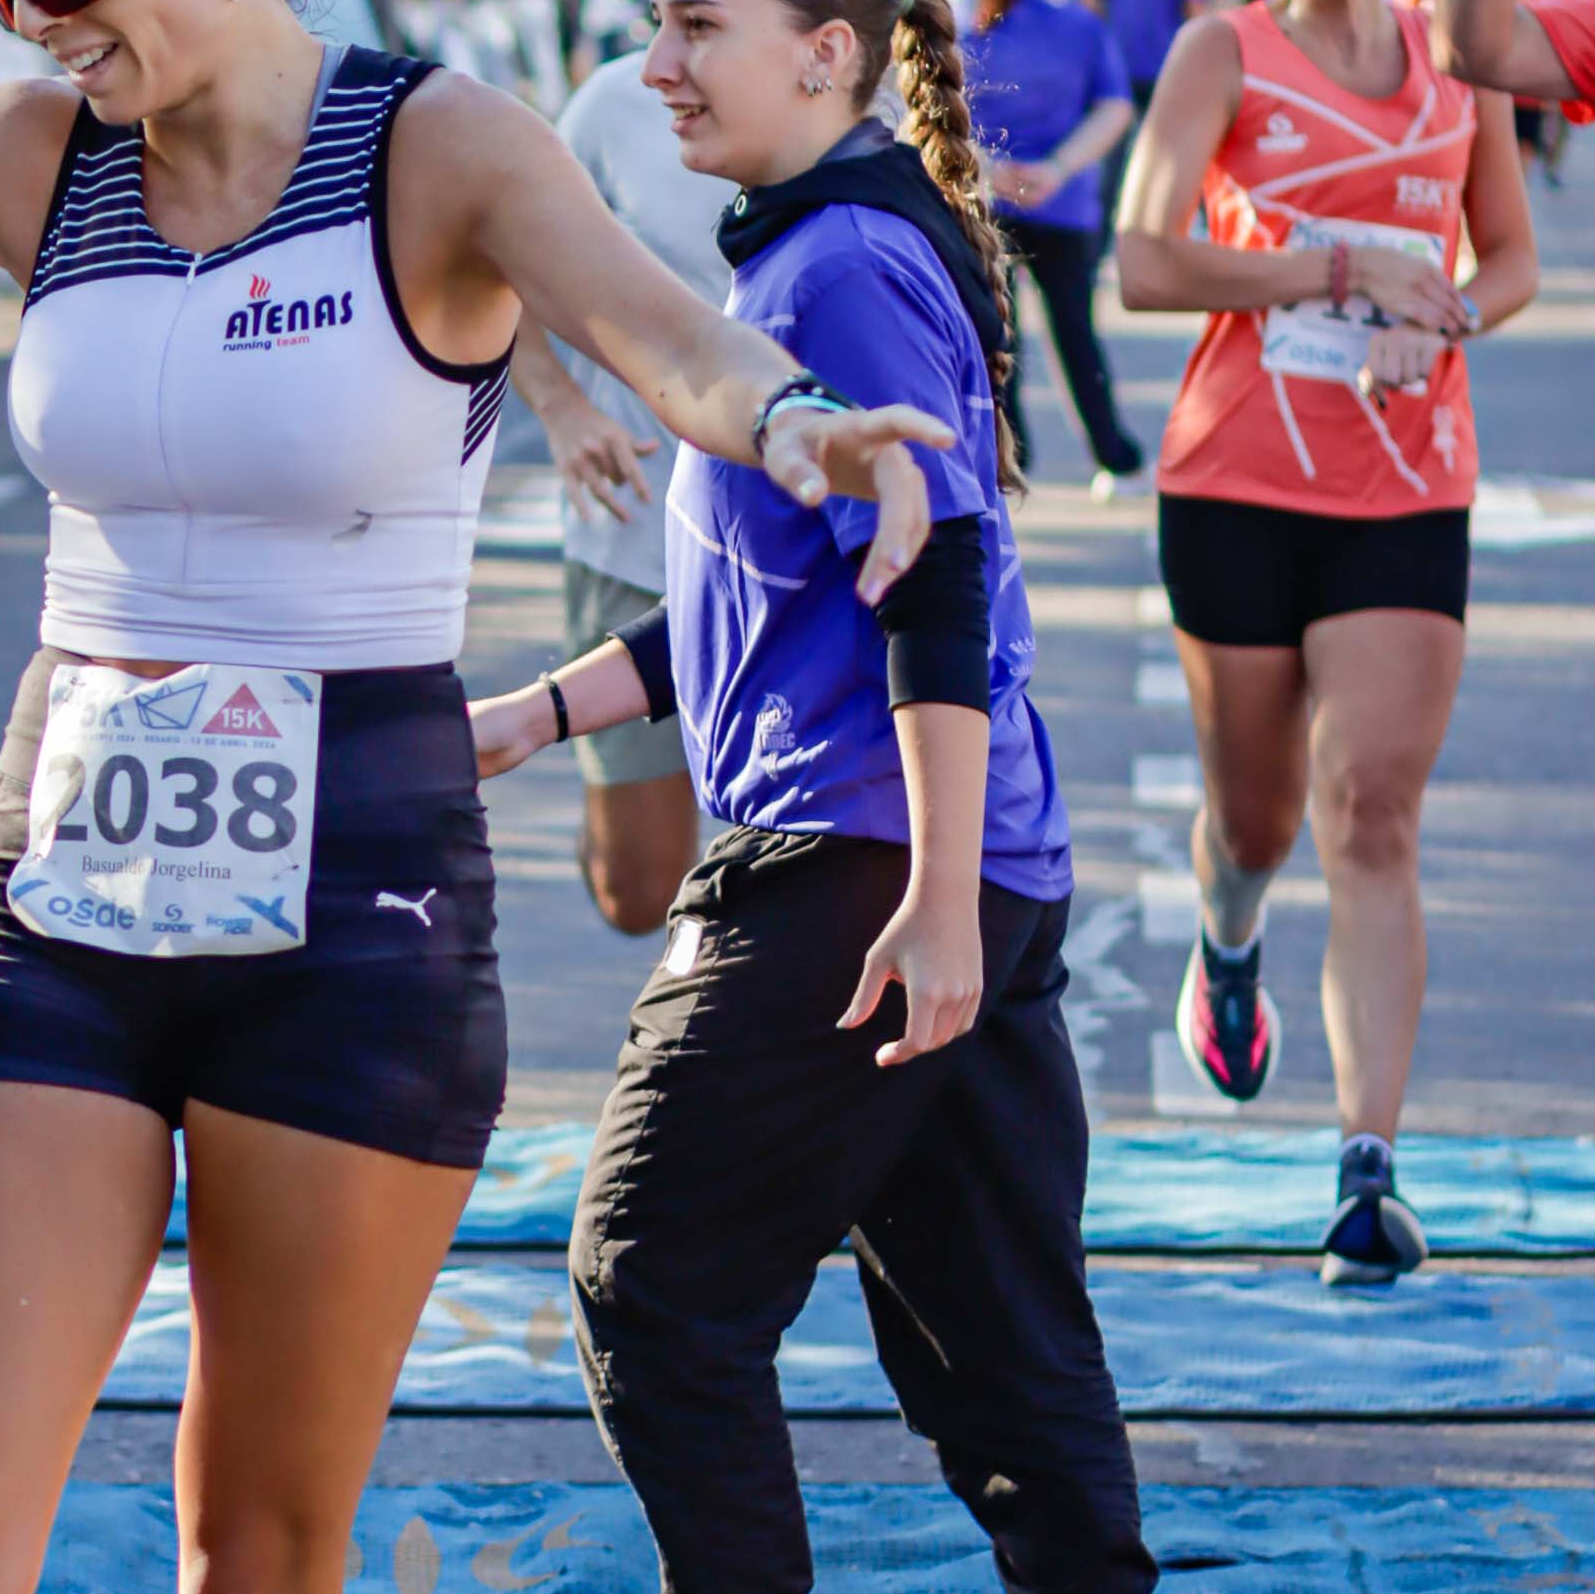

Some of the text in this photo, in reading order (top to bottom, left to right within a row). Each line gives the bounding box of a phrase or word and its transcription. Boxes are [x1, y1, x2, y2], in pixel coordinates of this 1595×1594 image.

[225, 291, 353, 340] ATENAS
[223, 334, 310, 352] running team
[220, 707, 264, 730] 15K
[40, 752, 298, 853] 2038
[150, 859, 232, 881] Jorgelina
[47, 896, 137, 930] osde
